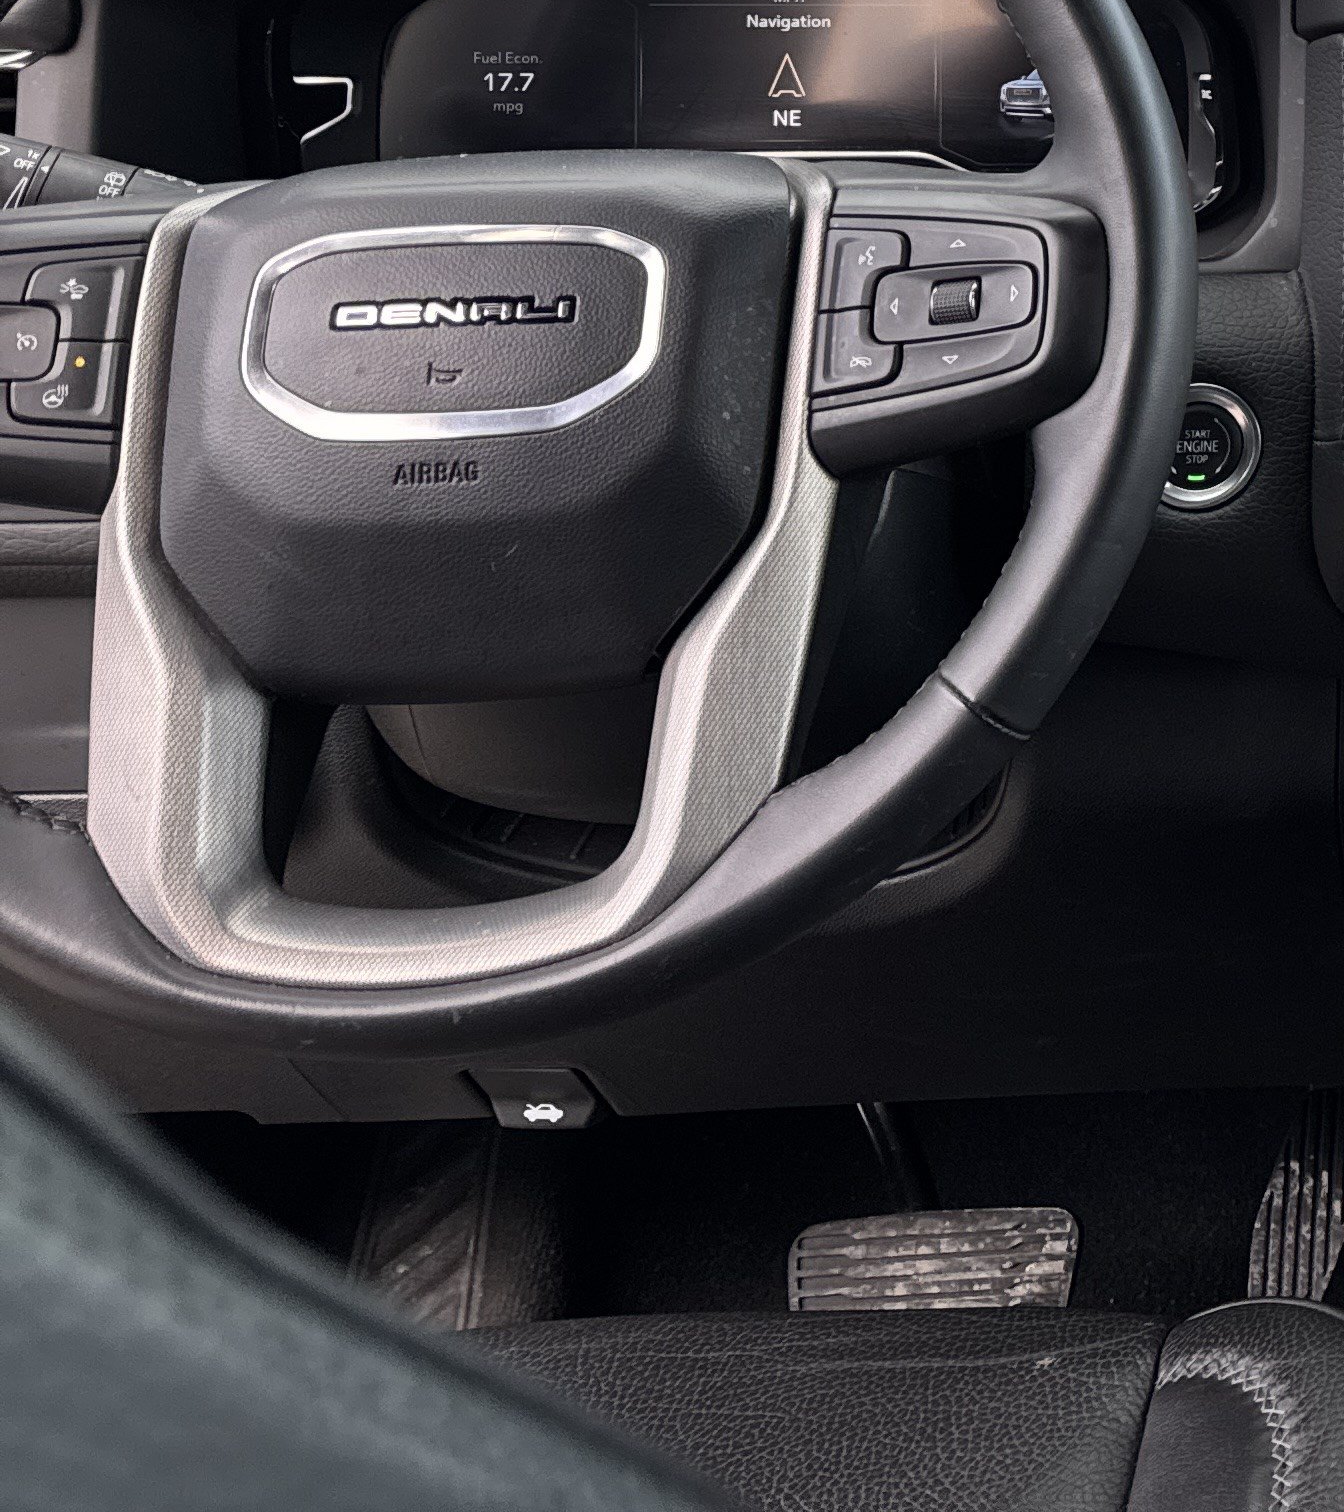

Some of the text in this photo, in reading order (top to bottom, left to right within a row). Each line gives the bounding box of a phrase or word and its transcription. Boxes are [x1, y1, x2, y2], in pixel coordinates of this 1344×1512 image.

[746, 14, 832, 32] Navigation
[473, 51, 543, 65] Fuel Econ.
[483, 71, 535, 92] 17.7
[492, 101, 524, 115] mpg
[772, 109, 802, 127] NE
[13, 158, 36, 171] OFF
[98, 184, 121, 197] OFF
[333, 297, 575, 329] DENALI
[1185, 429, 1211, 439] START
[1176, 440, 1219, 454] ENGINE
[1186, 454, 1209, 464] STOP
[392, 459, 480, 486] AIRBAG
